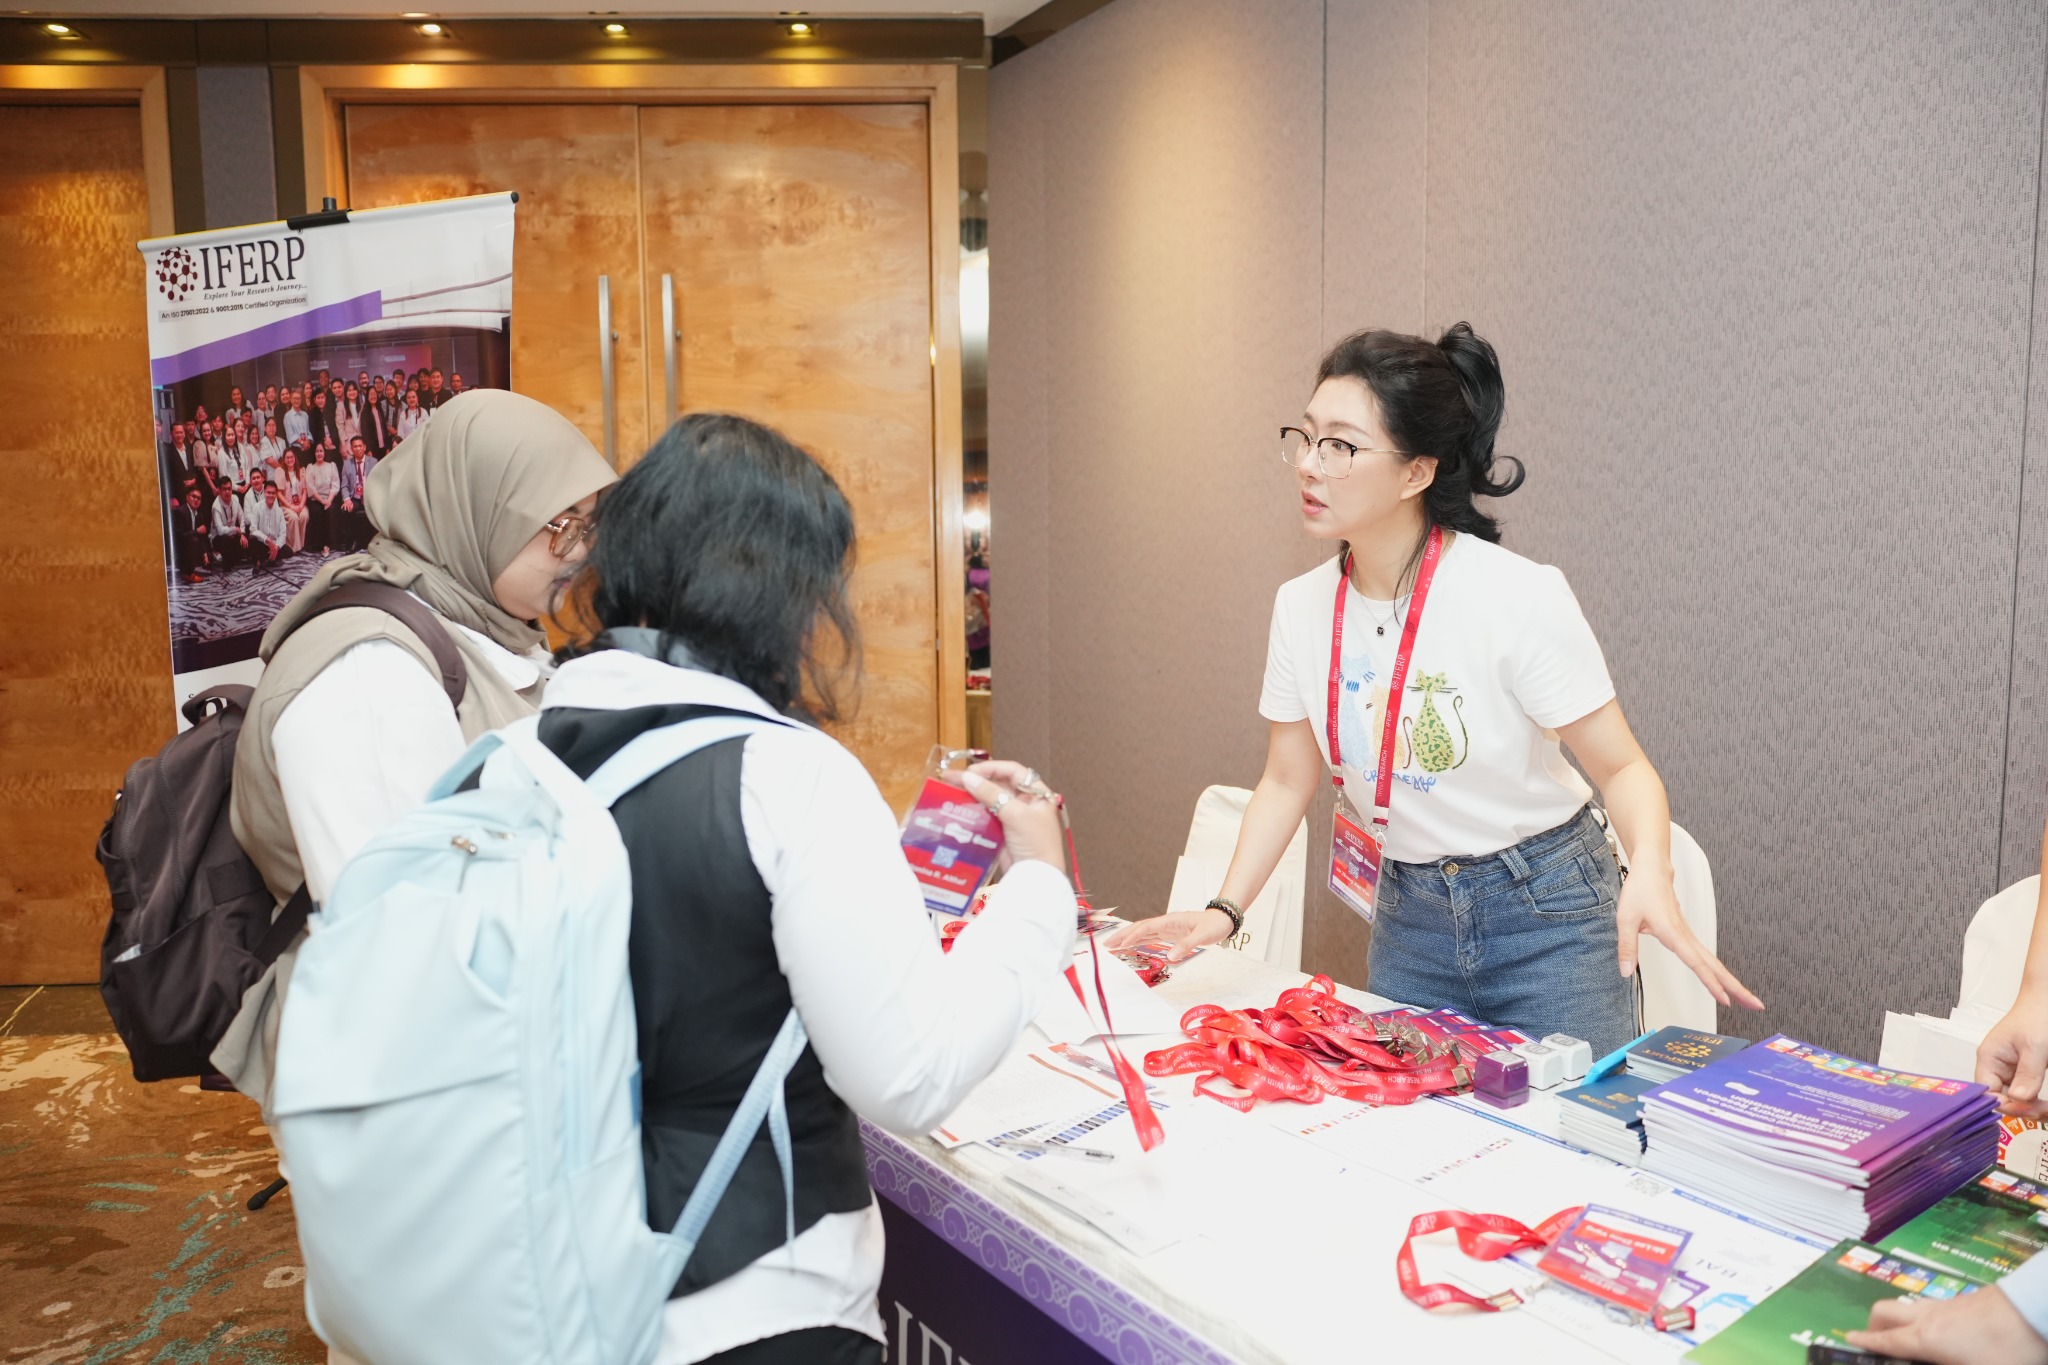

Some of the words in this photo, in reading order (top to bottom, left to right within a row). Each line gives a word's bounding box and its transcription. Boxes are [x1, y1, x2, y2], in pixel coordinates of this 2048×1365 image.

[199, 236, 305, 290] IFERP
[203, 291, 228, 302] Explore
[230, 288, 245, 297] Your
[247, 285, 275, 296] Research
[161, 311, 170, 319] An
[171, 310, 180, 318] ISO
[180, 307, 209, 317] 27001:2022
[244, 301, 269, 310] Certified
[269, 296, 307, 308] Organization
[1335, 611, 1343, 636] IFERP
[1394, 654, 1405, 680] IFERP
[1379, 750, 1388, 781] RESEARCH
[1350, 1046, 1368, 1056] IFERP
[1642, 1049, 1706, 1068] PASSPORT
[1267, 1077, 1285, 1090] With
[1312, 1074, 1339, 1094] IFERP
[1387, 1075, 1420, 1084] RESEARCH
[1421, 1075, 1441, 1083] THINK
[1364, 1093, 1385, 1101] IFERP
[1693, 1087, 1750, 1110] Research
[1706, 1097, 1720, 1105] on
[1730, 1094, 1792, 1116] Education
[1720, 1102, 1776, 1122] Conference
[1792, 1111, 1820, 1124] and
[1820, 1119, 1872, 1137] Studies
